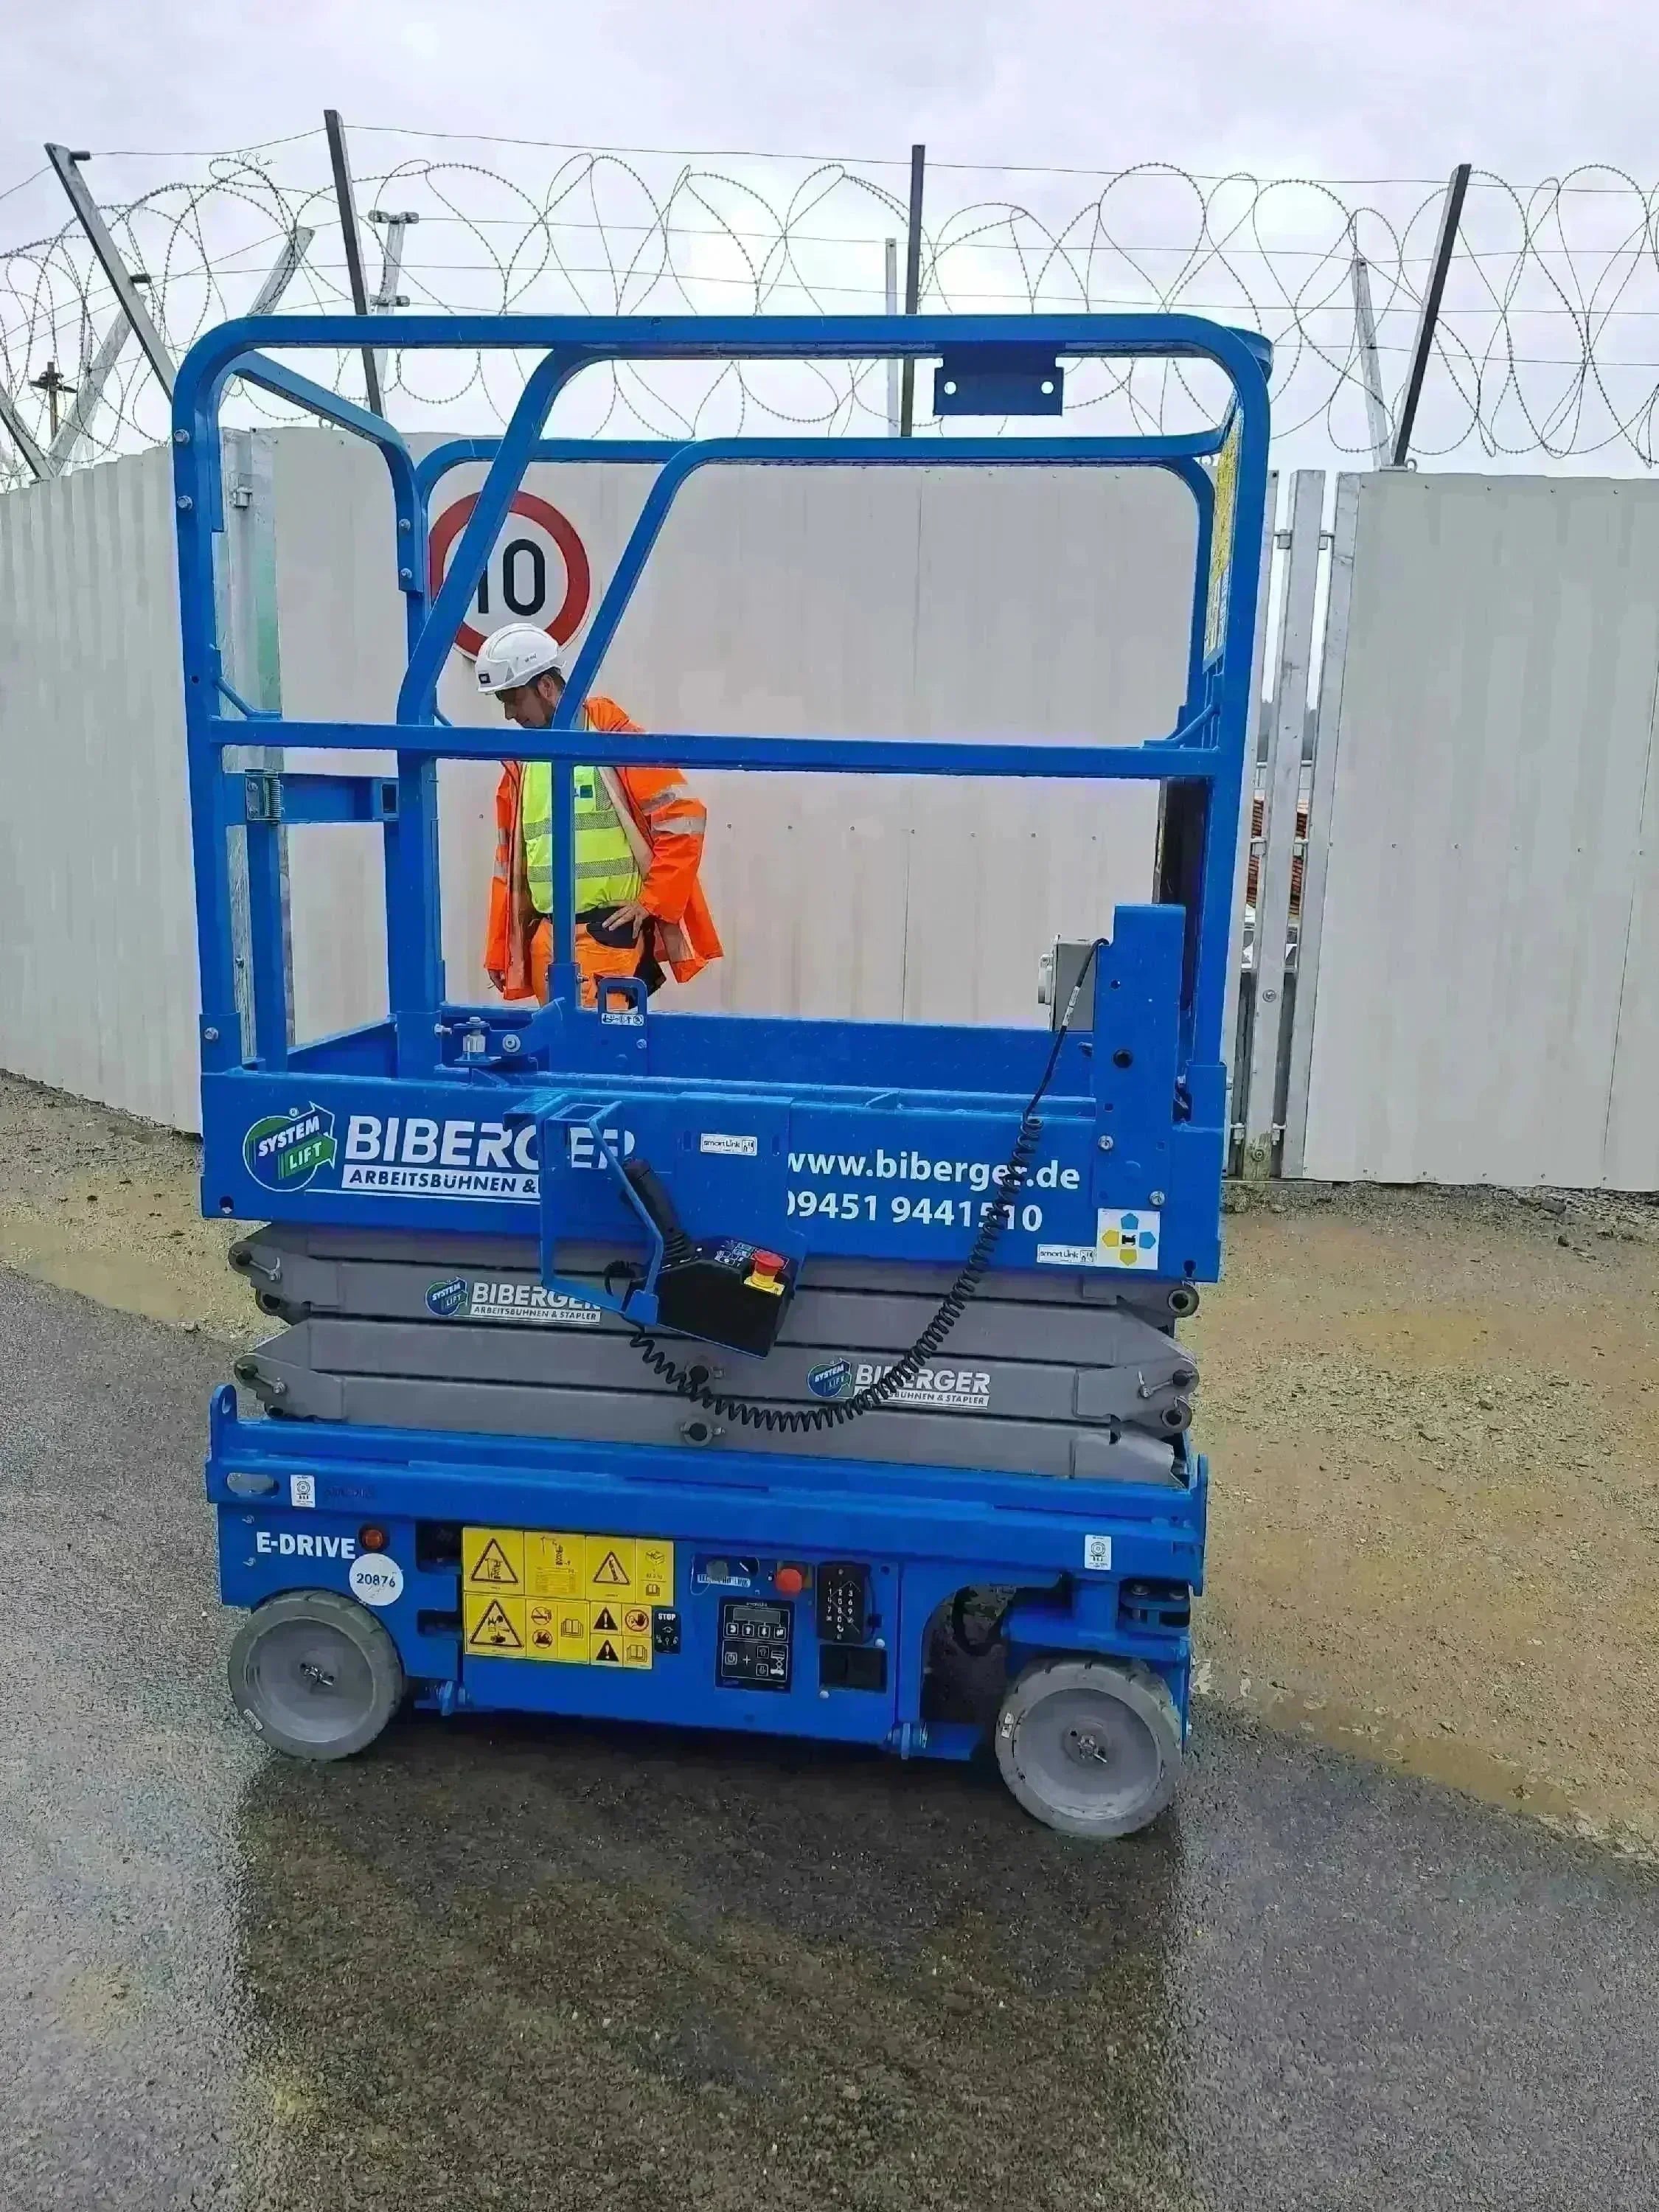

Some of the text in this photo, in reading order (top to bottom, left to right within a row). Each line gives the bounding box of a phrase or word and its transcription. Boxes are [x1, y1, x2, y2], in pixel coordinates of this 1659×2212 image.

[258, 1116, 320, 1158] SYSTEM
[288, 1141, 323, 1170] LIFT
[349, 1169, 537, 1194] ARBEITSBÜHNEN &
[560, 1311, 597, 1321] STAPLER
[256, 1531, 356, 1559] E-DRIVE
[356, 1573, 396, 1587] 20876
[658, 1613, 676, 1621] STOP
